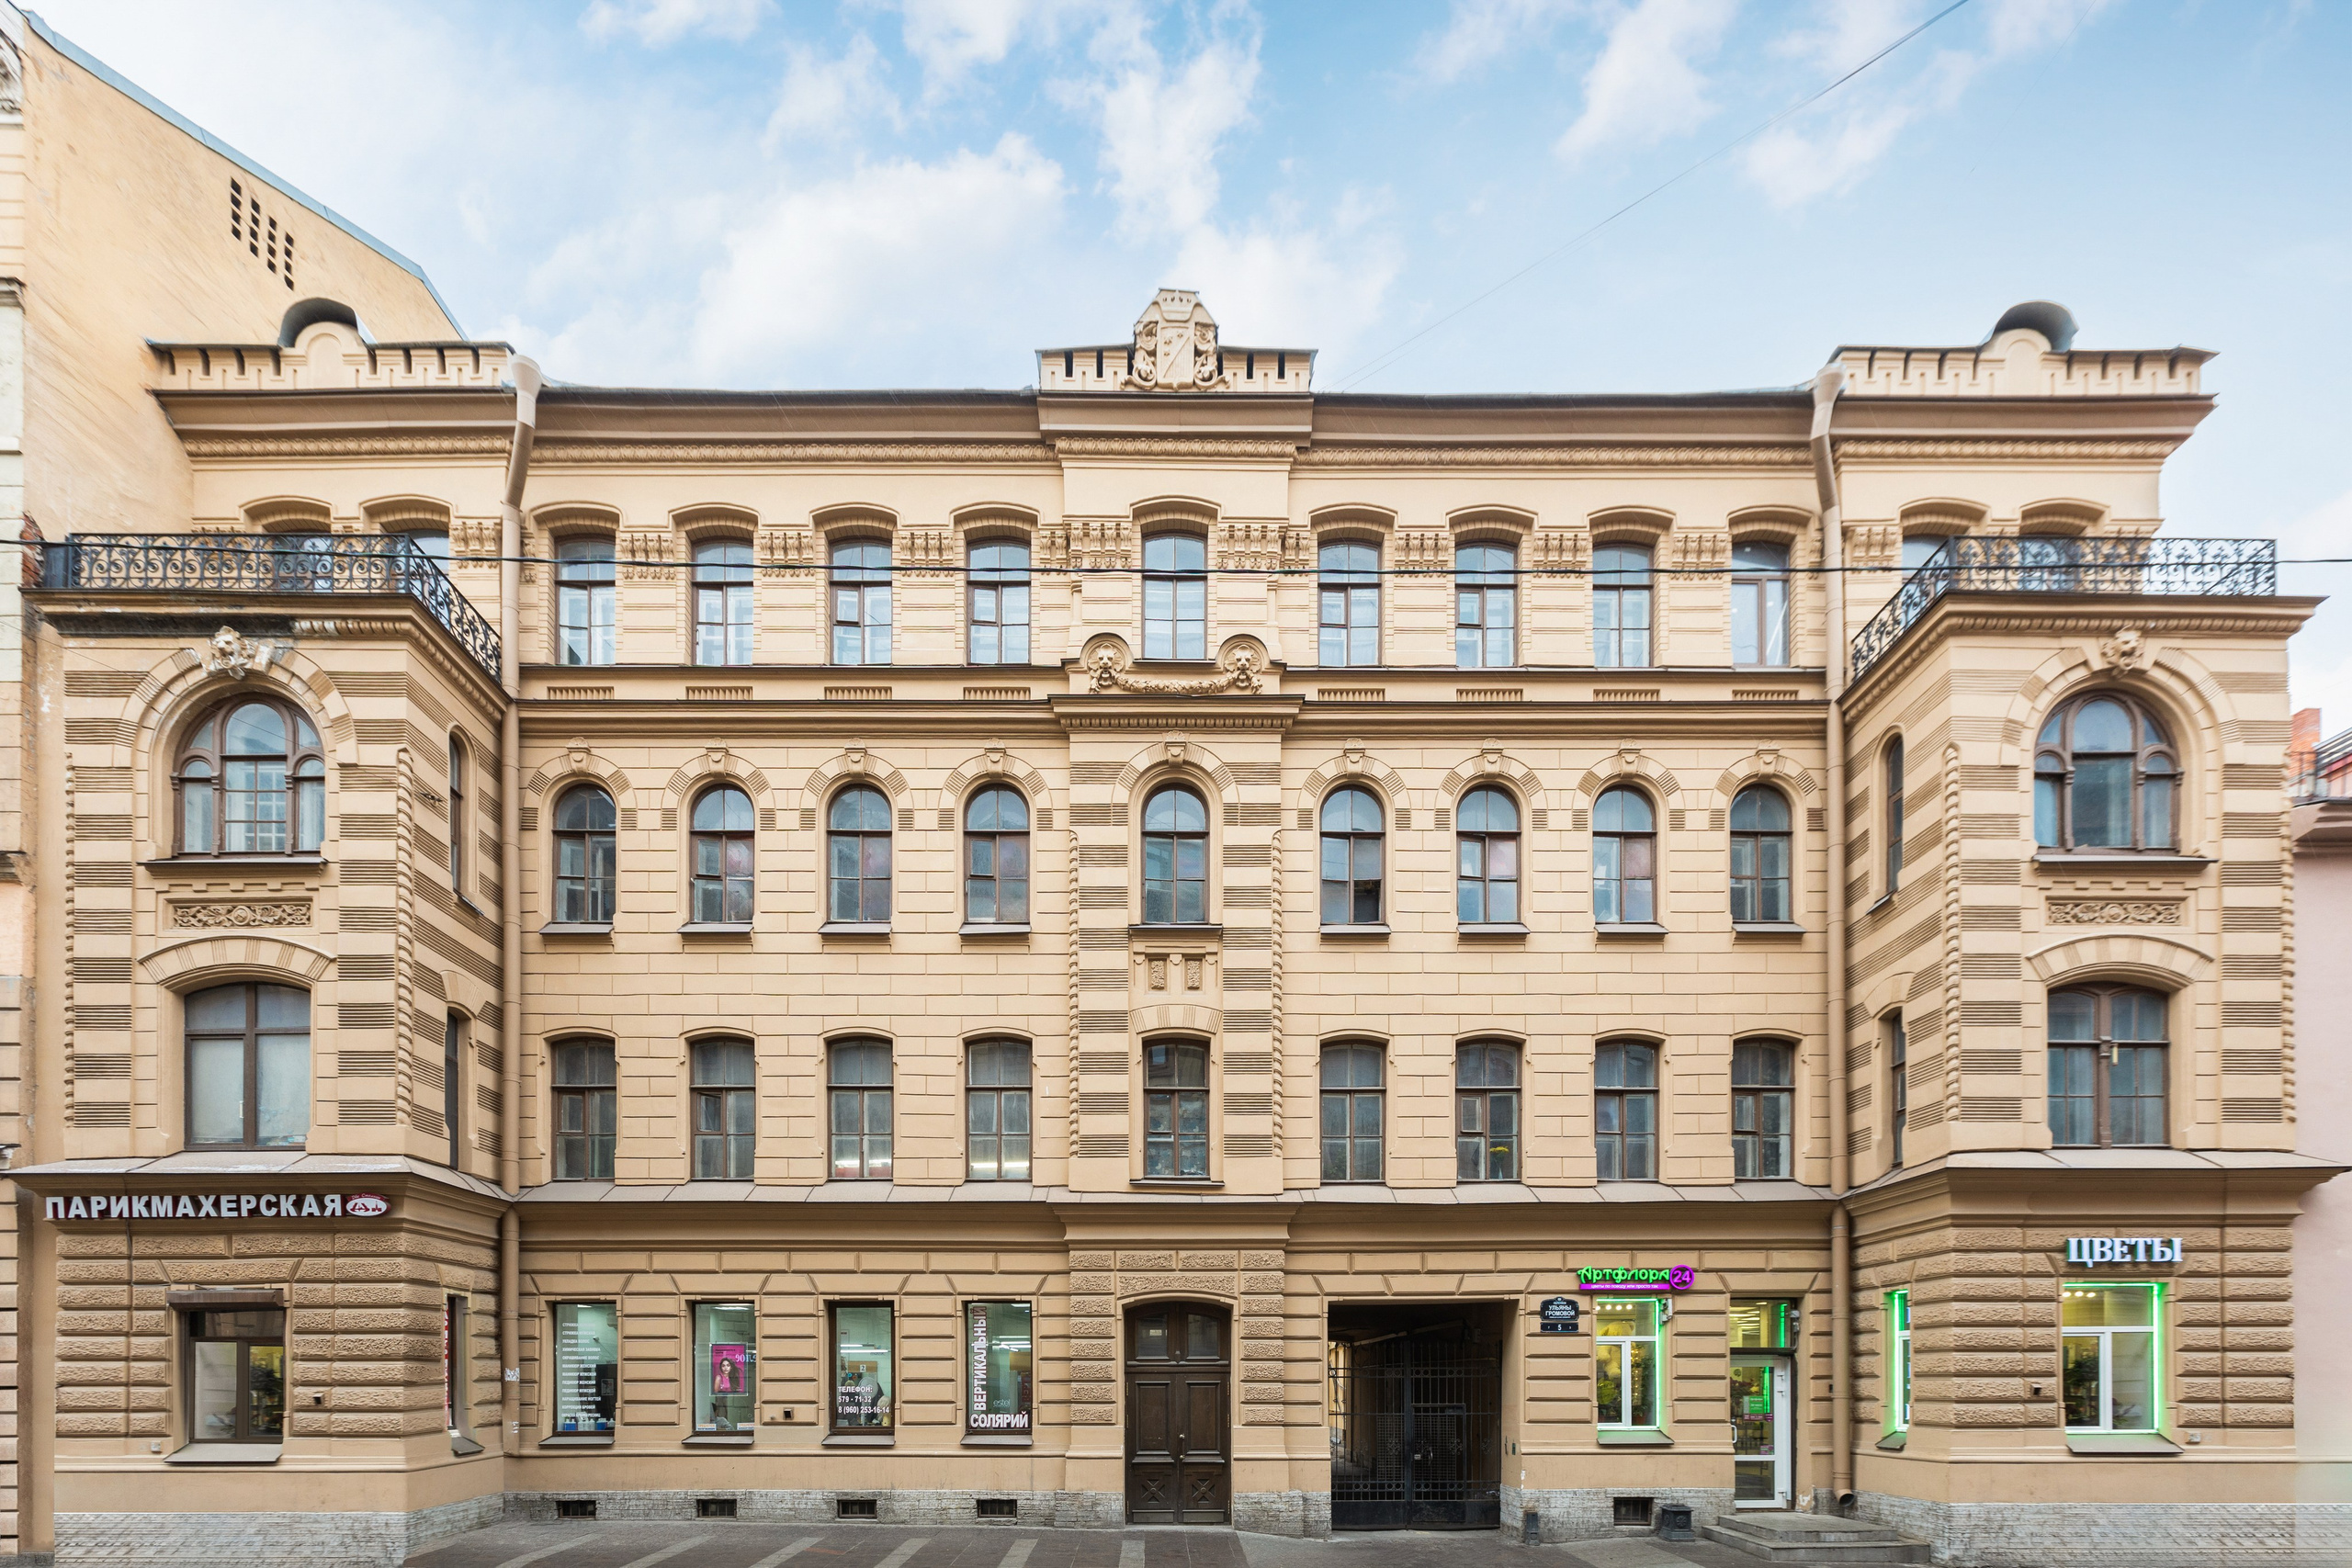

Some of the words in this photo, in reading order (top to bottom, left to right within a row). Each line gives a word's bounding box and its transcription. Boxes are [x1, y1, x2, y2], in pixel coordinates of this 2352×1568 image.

[46, 1194, 342, 1219] ПАРИКМАХЕРСКАЯ
[2066, 1237, 2184, 1268] ЦВЕТЫ
[1577, 1266, 1669, 1283] Артфлора
[1673, 1270, 1691, 1283] 24
[970, 1305, 987, 1411] ВЕРТИКАЛЬНЫЙ
[843, 1405, 859, 1415] (960)
[993, 1398, 1010, 1406] estel
[970, 1411, 1028, 1428] СОЛЯРИЙ
